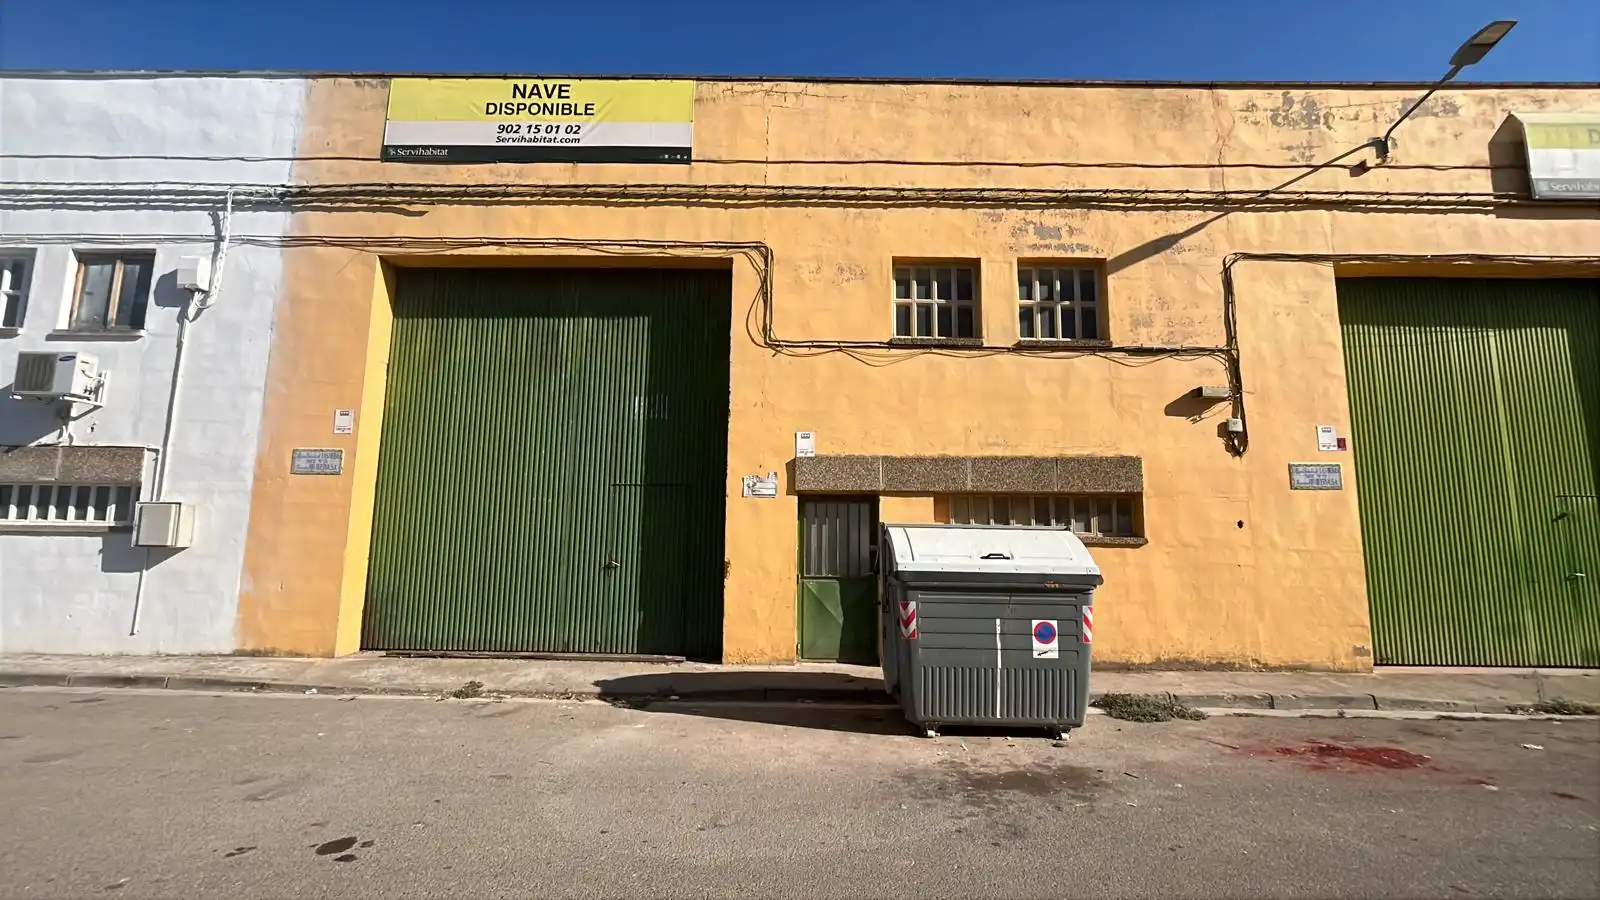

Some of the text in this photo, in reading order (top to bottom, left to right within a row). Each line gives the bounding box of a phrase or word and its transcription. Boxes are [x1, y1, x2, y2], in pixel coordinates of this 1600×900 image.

[512, 83, 571, 99] NAVE
[485, 102, 595, 116] DISPONIBLE
[497, 124, 582, 135] 902 15 01 02
[495, 135, 580, 144] Servihabitat.com
[397, 147, 448, 156] Servihabitat
